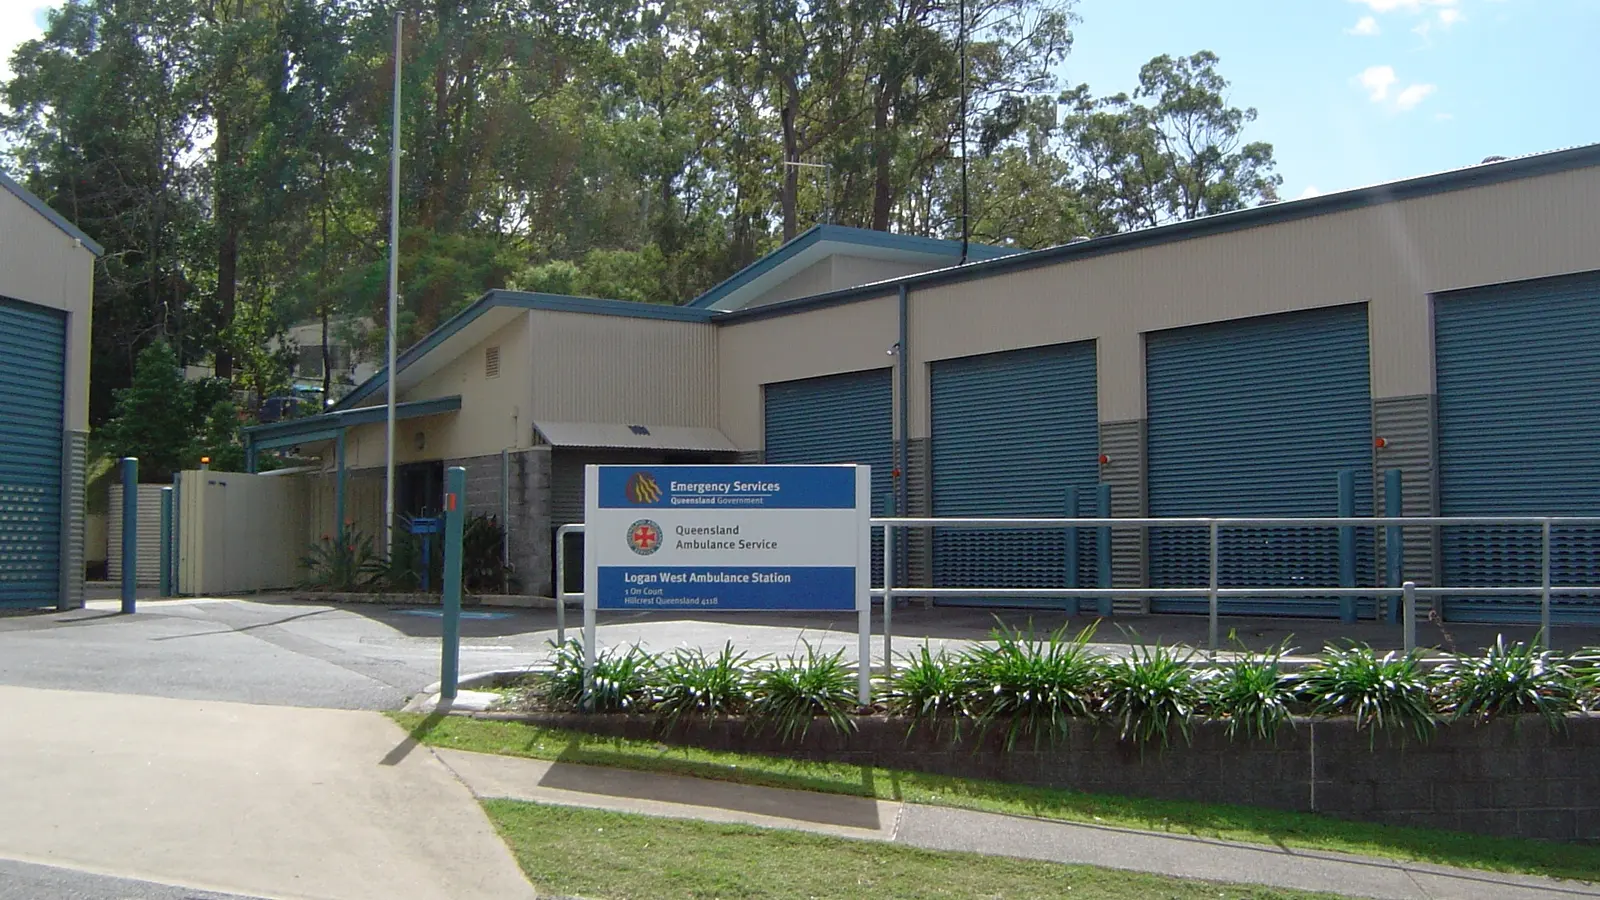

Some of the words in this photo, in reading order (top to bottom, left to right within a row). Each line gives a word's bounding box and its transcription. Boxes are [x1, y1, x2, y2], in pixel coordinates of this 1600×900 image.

[670, 480, 731, 494] Emergency
[734, 480, 780, 492] Services
[670, 496, 716, 505] Queensland
[716, 496, 764, 505] Government
[676, 525, 739, 536] Queensland
[676, 540, 736, 550] Ambulance
[738, 540, 778, 550] Service
[624, 572, 658, 584] Logan
[660, 572, 687, 583] West
[689, 572, 749, 583] Ambulance
[752, 572, 792, 583] Station
[643, 588, 663, 596] Court
[656, 597, 700, 606] Queensland
